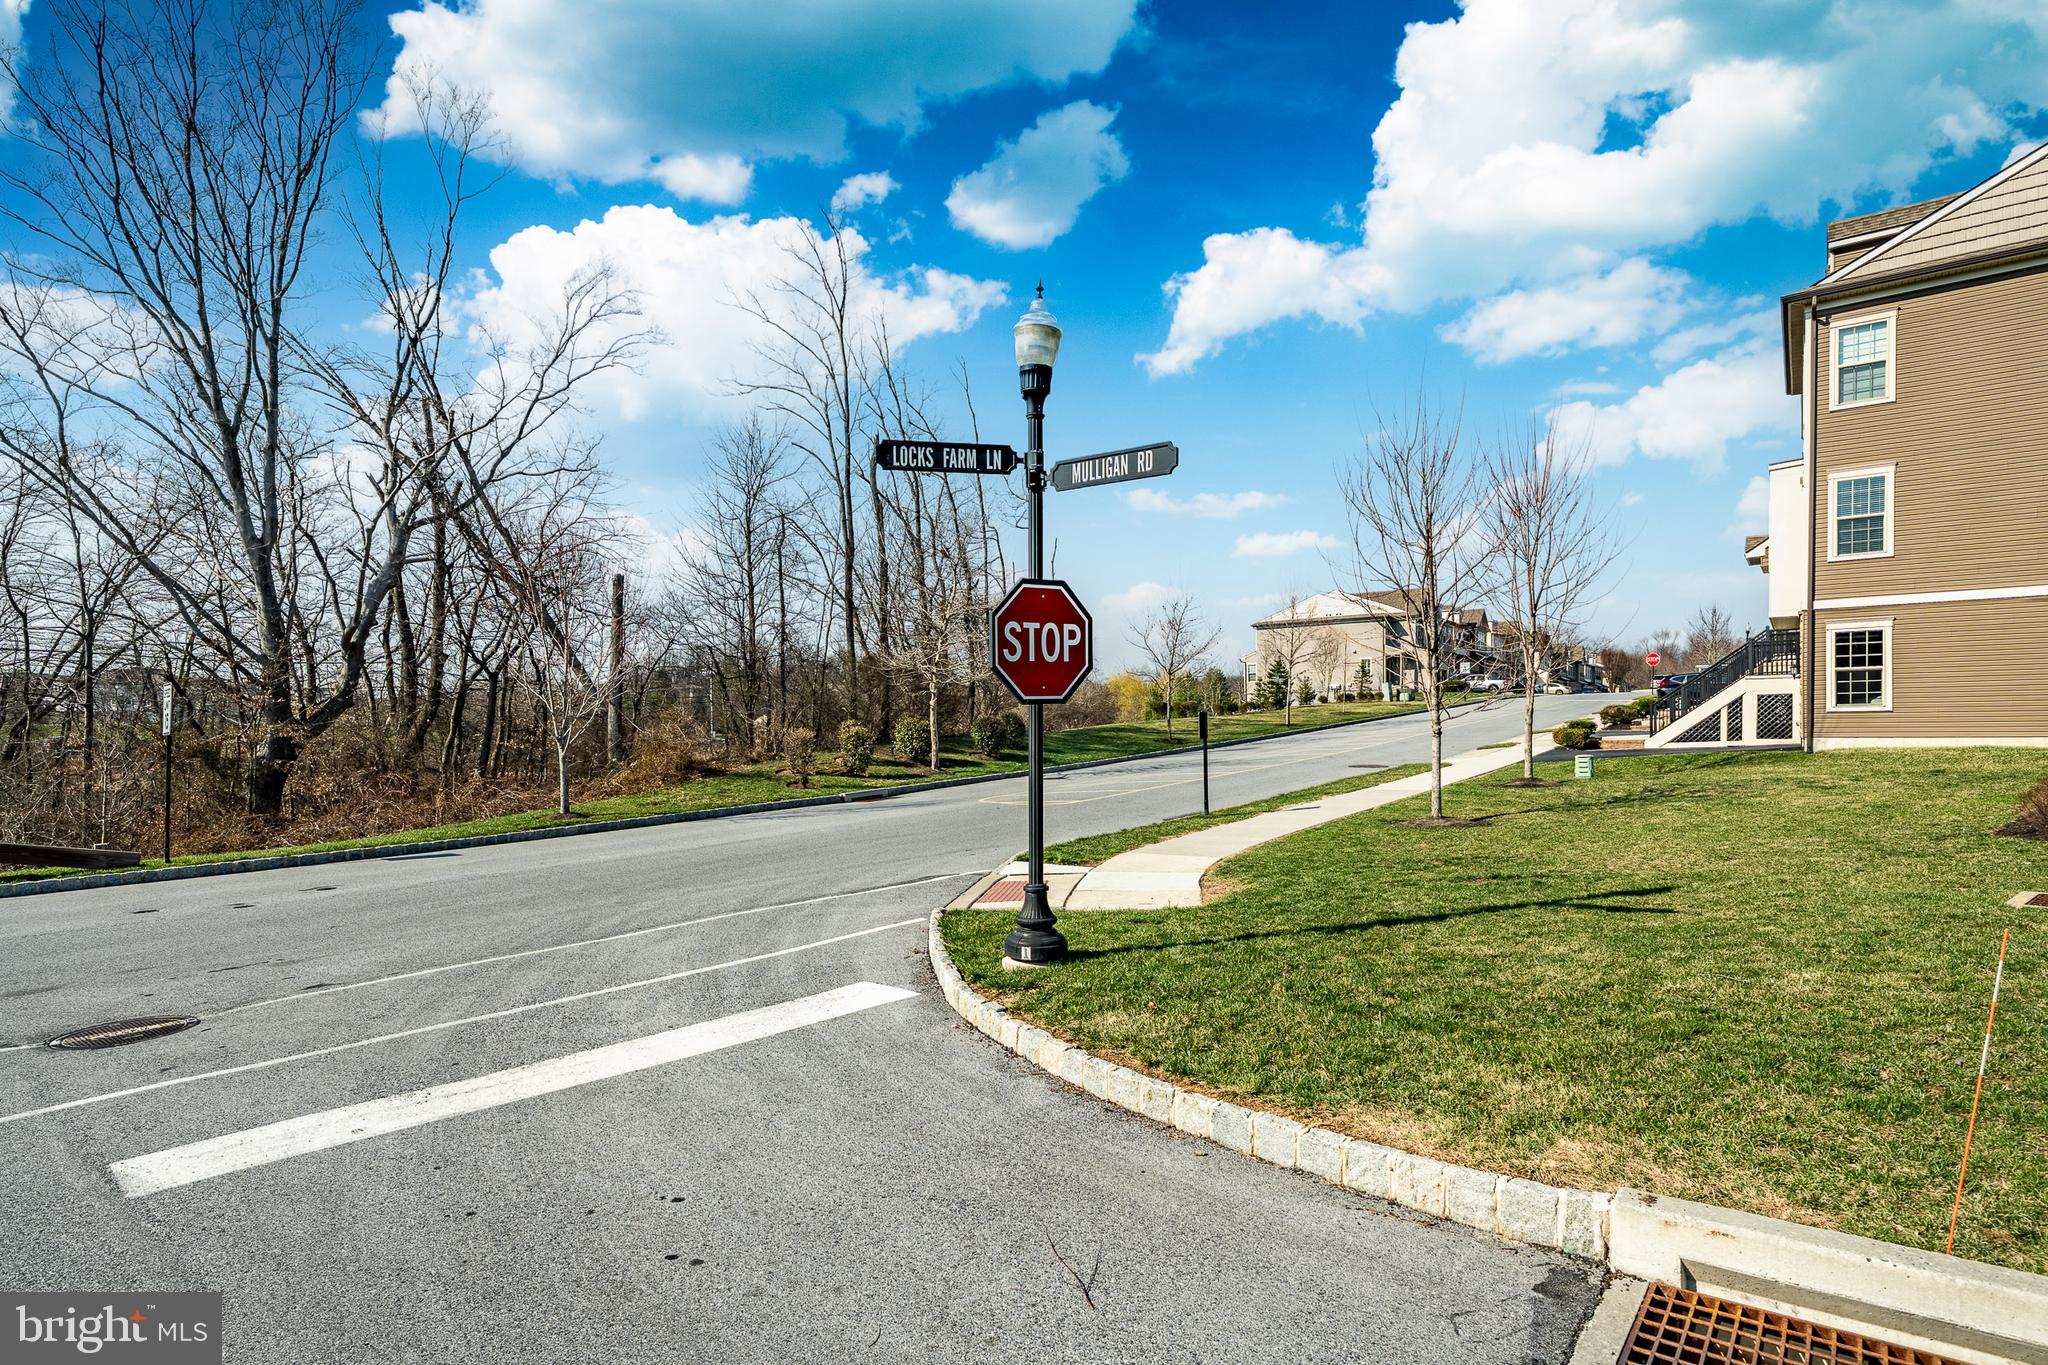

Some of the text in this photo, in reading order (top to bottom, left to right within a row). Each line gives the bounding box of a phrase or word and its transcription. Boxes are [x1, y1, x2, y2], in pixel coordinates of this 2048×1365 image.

[892, 445, 1002, 470] LOCKS FARM LN
[1072, 449, 1154, 484] MULLIGAN RD
[1002, 620, 1082, 663] STOP
